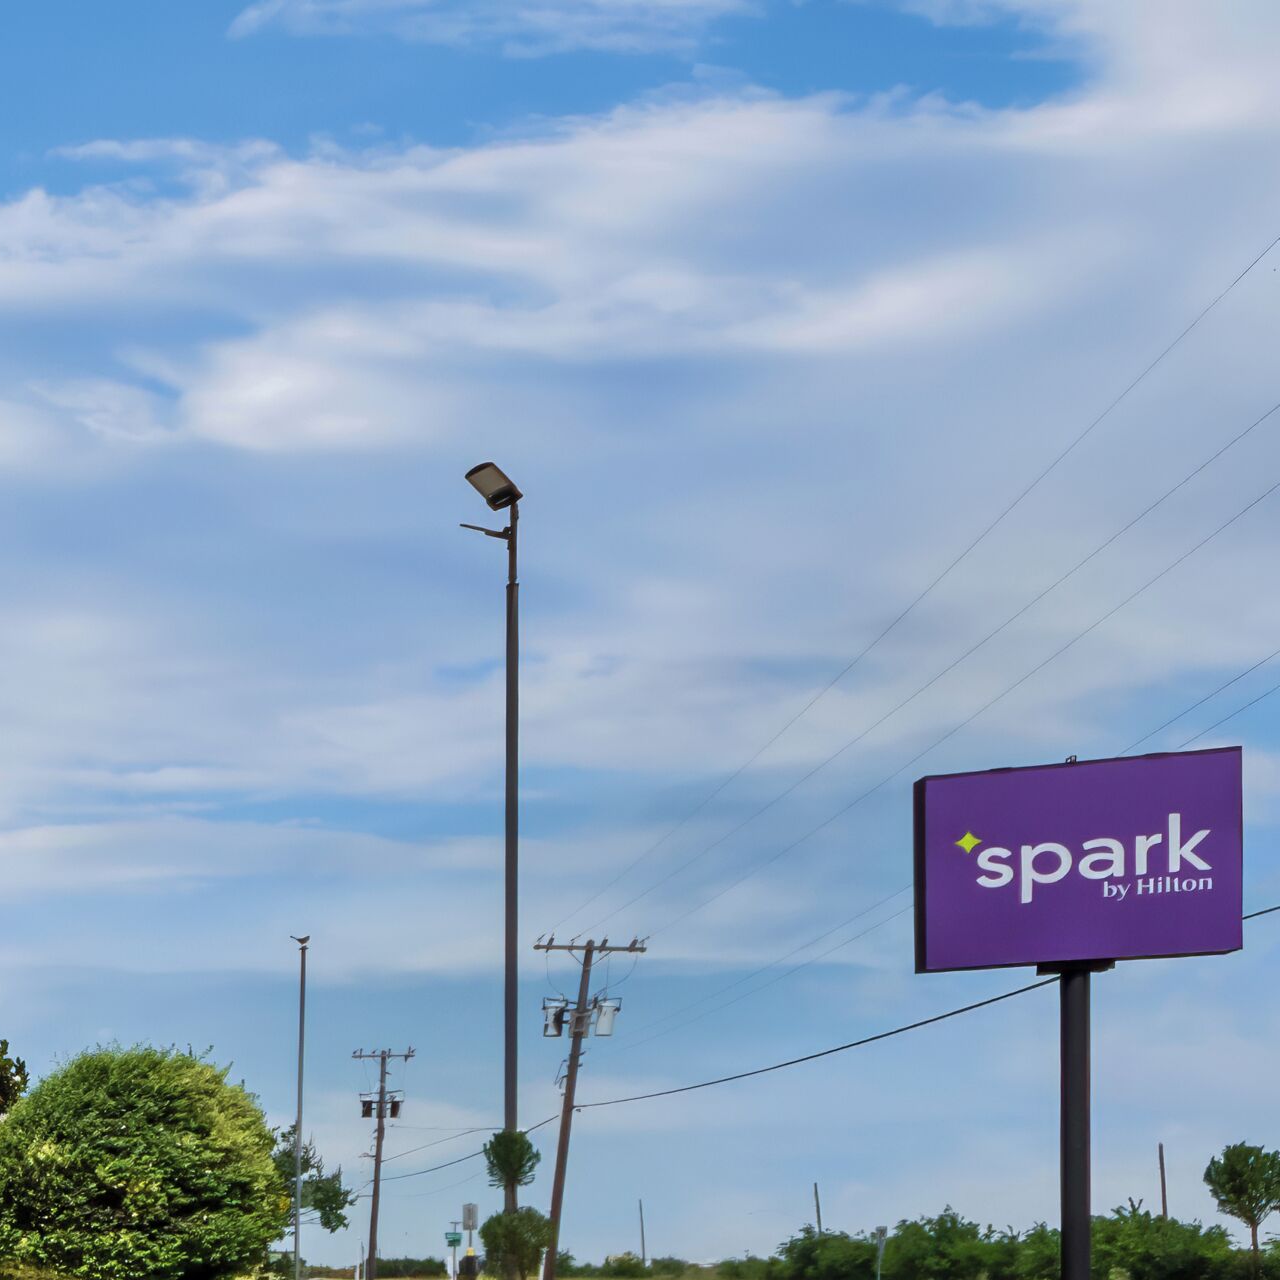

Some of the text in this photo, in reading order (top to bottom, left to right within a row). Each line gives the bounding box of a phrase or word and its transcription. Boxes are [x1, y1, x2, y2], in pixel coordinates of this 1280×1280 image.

[976, 812, 1213, 904] spark
[1103, 876, 1213, 901] by Hilton
